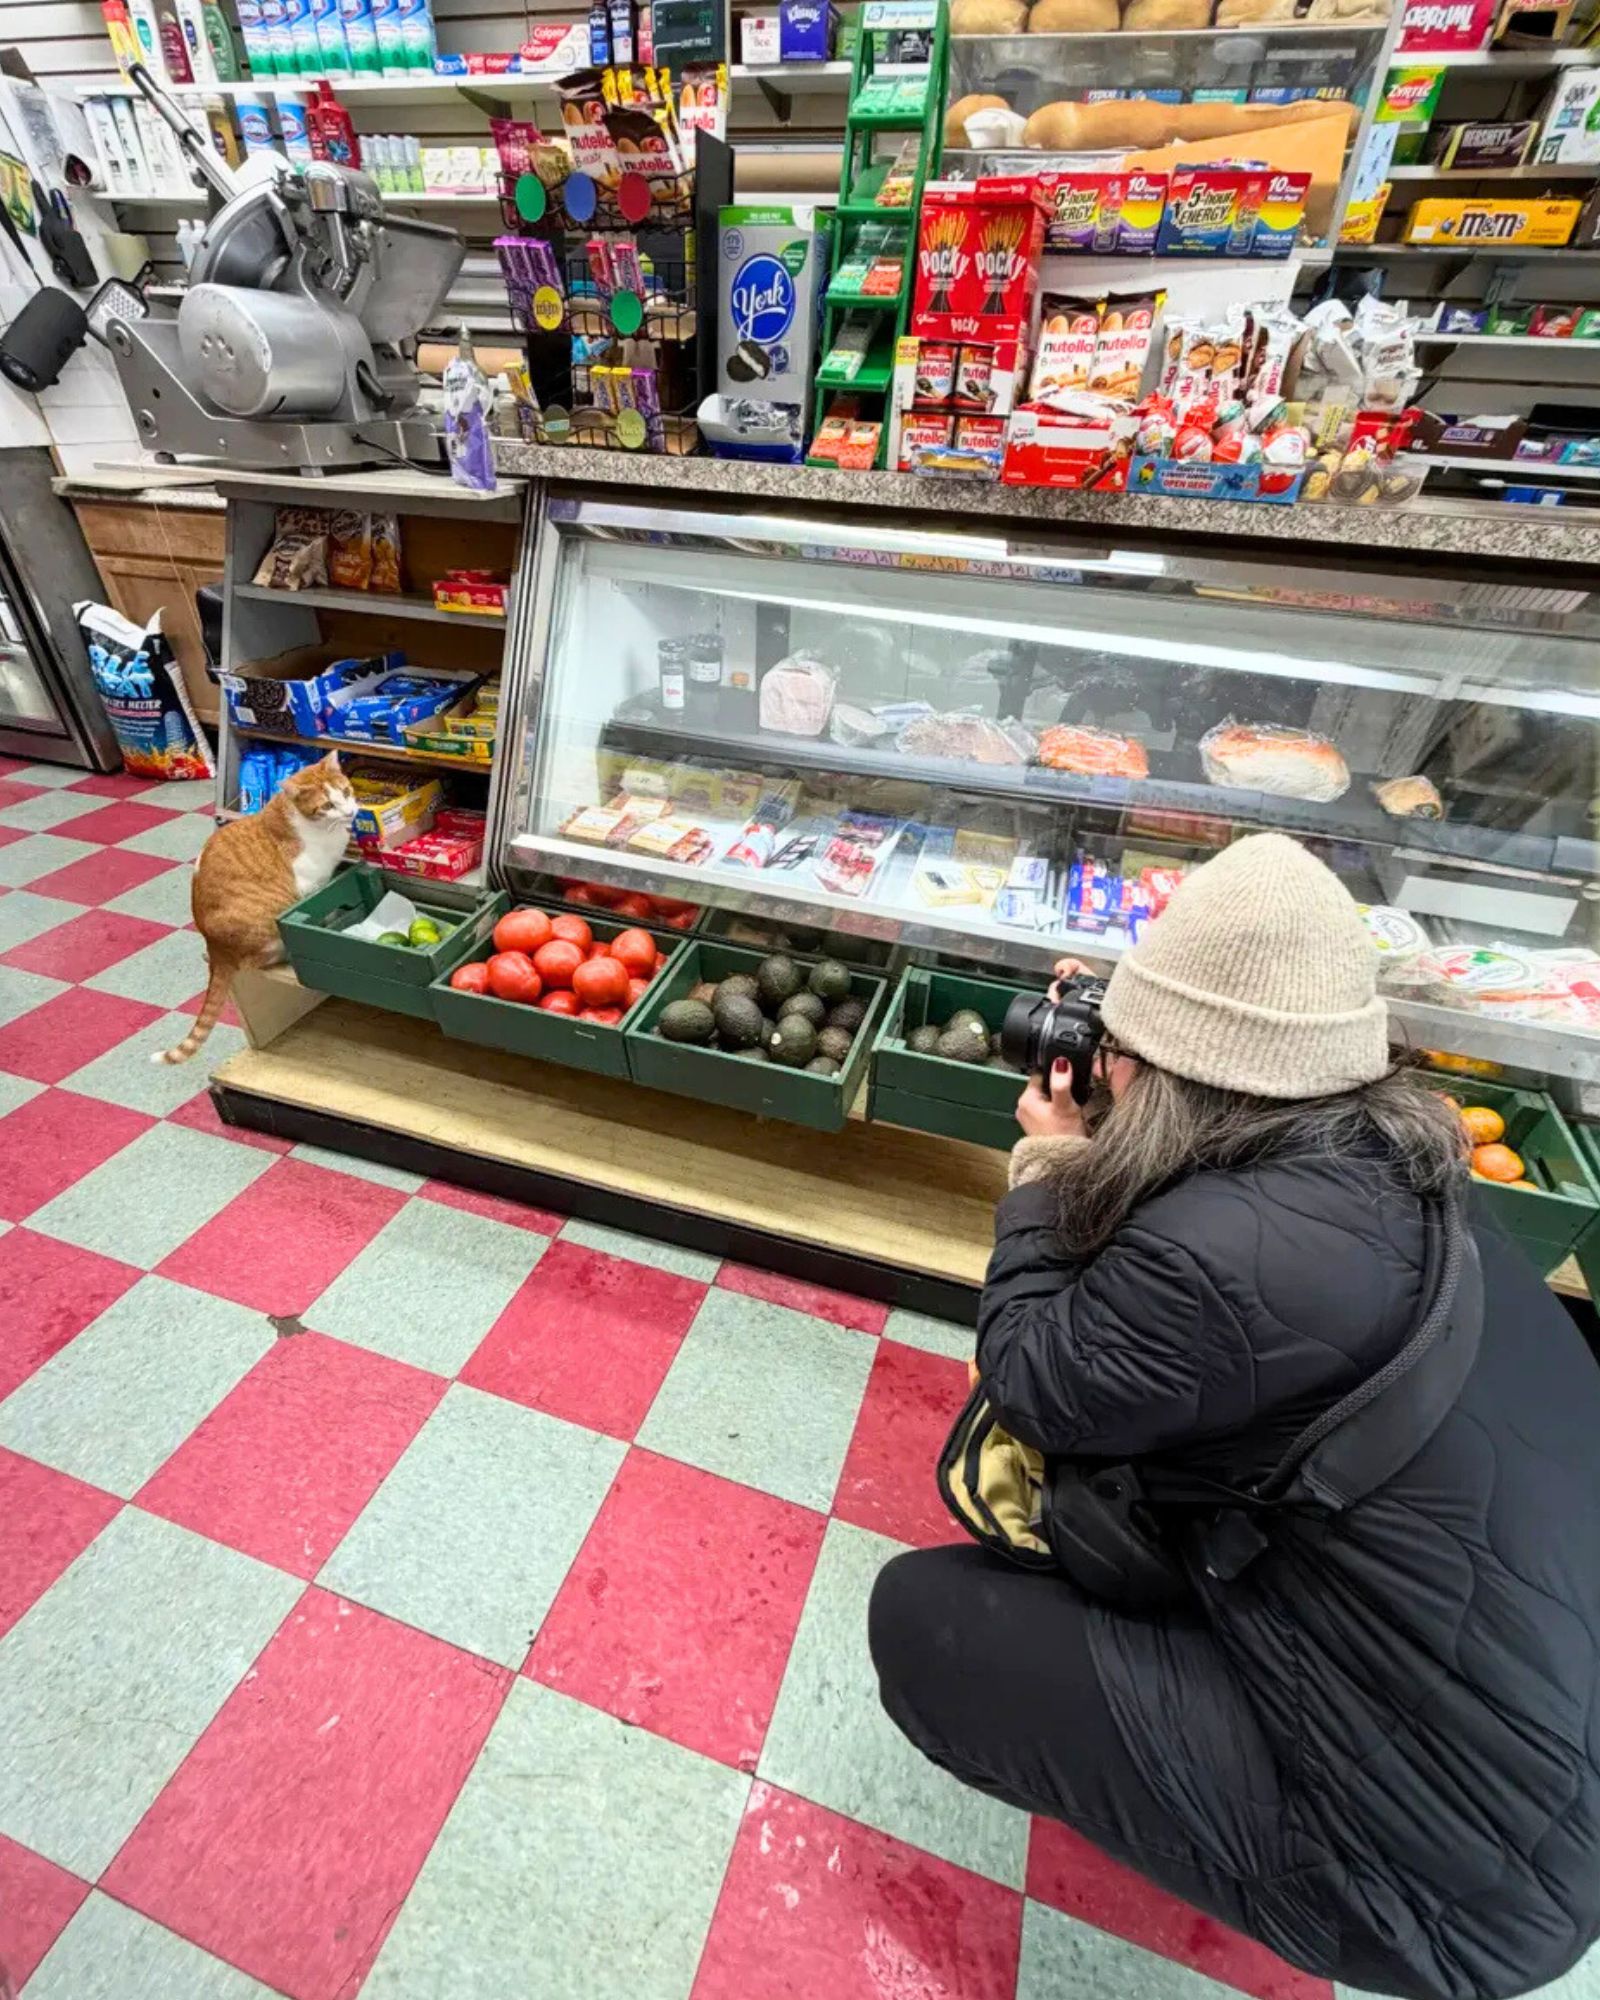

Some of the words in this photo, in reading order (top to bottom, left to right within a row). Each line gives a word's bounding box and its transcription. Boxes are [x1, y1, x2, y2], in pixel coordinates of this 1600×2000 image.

[570, 131, 615, 150] nutella
[624, 157, 674, 171] nutella
[1128, 176, 1147, 192] 10
[1269, 176, 1289, 191] 10
[1179, 205, 1231, 225] ENERGY
[733, 270, 792, 343] York
[1044, 339, 1095, 353] nutella
[1097, 334, 1148, 351] nutella
[964, 366, 990, 381] nutel
[907, 431, 945, 446] nutella
[962, 435, 998, 448] nutella
